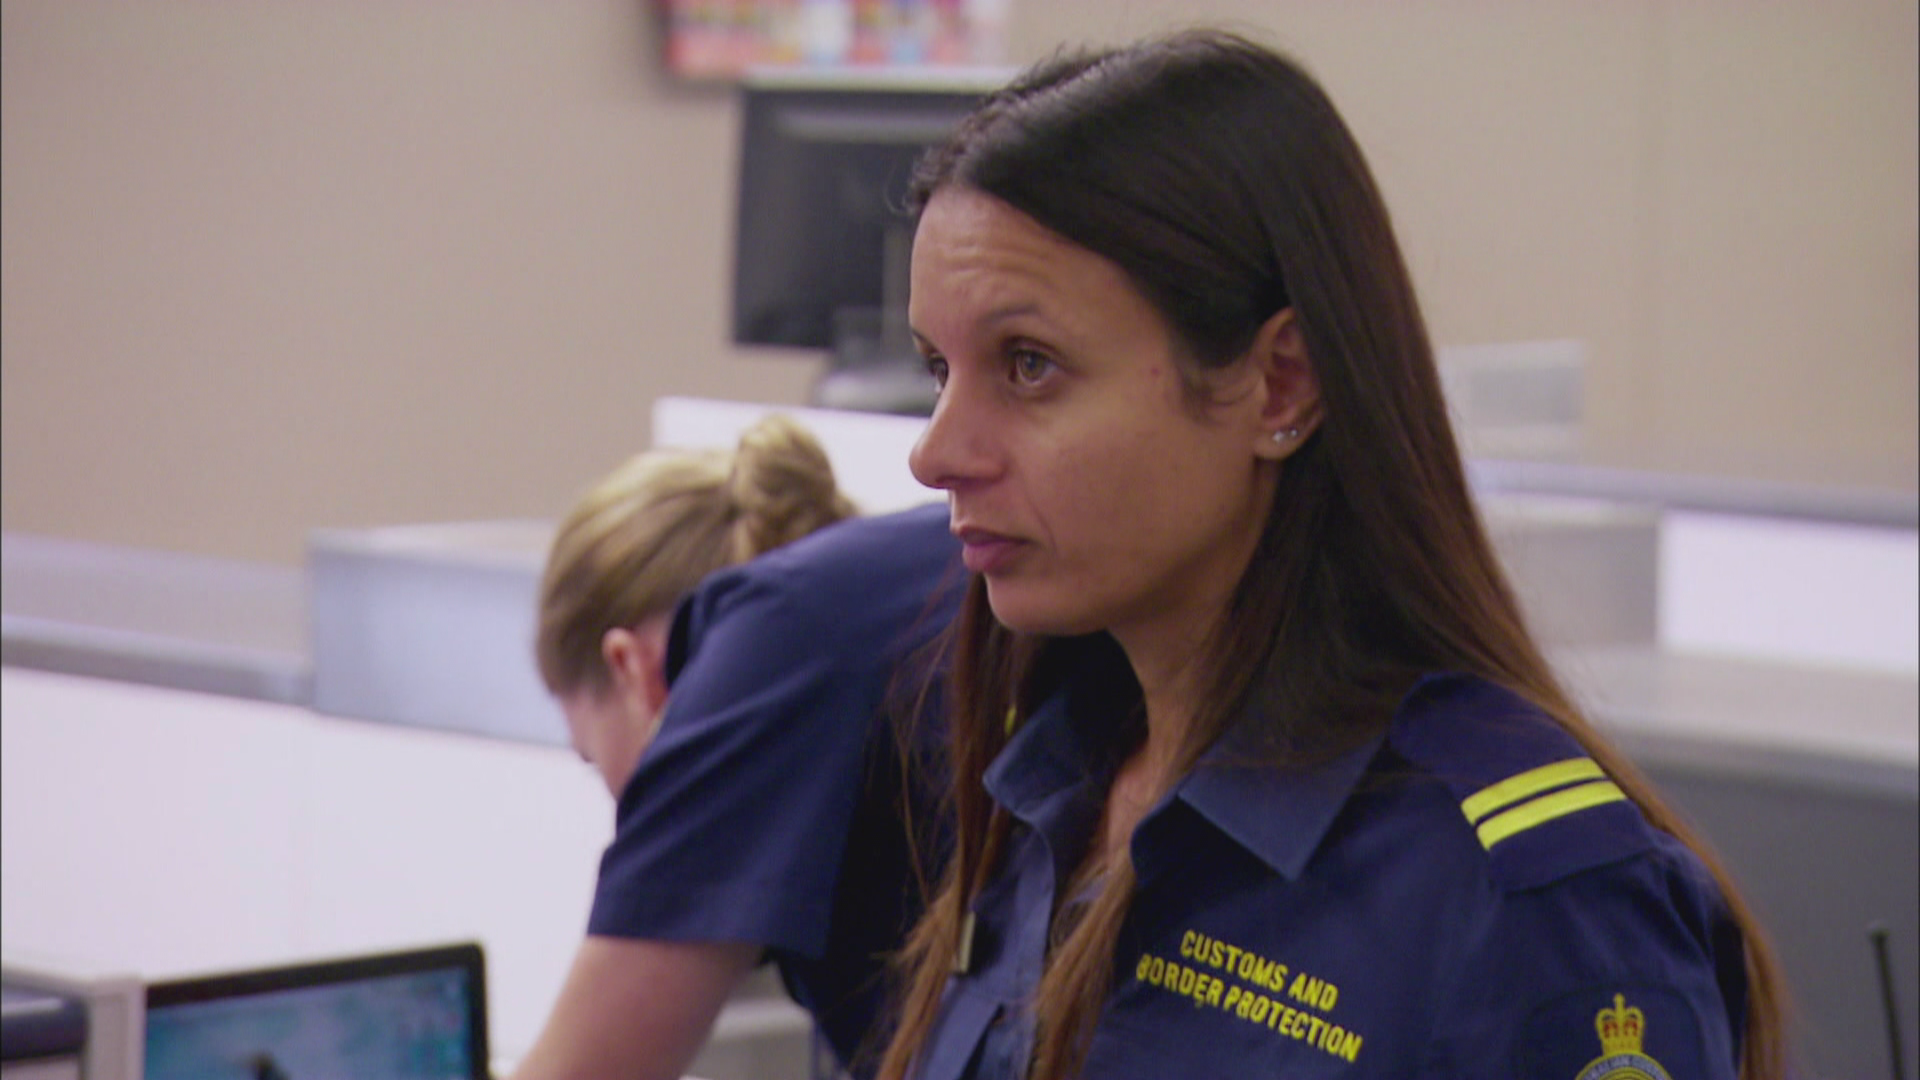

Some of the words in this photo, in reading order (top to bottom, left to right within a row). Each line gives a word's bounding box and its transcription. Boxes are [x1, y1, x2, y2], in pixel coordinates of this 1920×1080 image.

[1136, 953, 1225, 1007] BORDER
[1223, 985, 1363, 1063] PROTECTION
[1180, 929, 1288, 993] CUSTOMS
[1288, 972, 1339, 1012] AND
